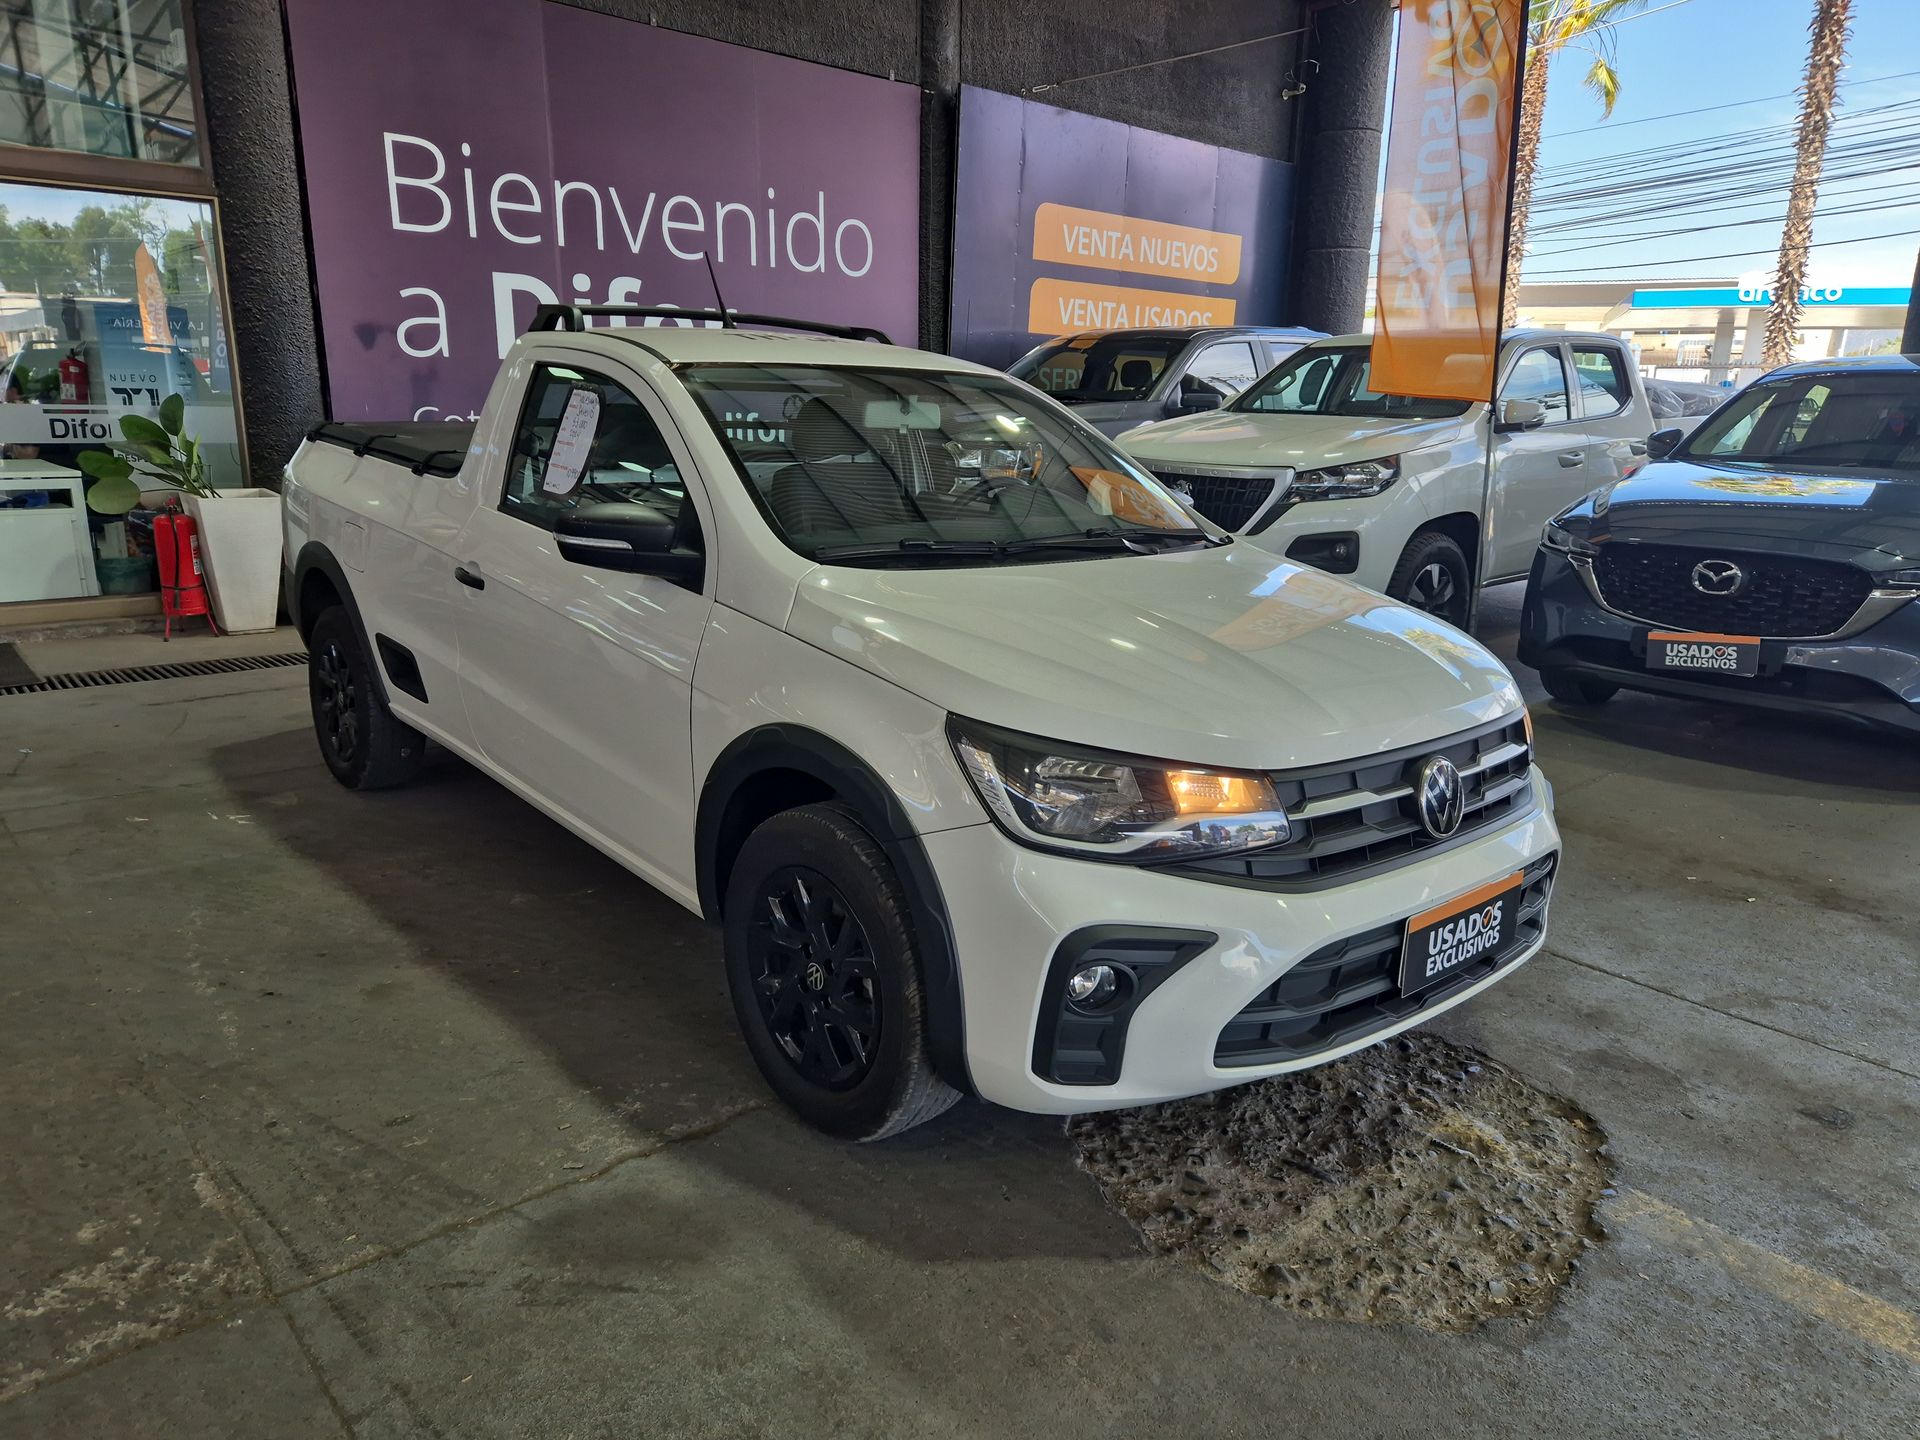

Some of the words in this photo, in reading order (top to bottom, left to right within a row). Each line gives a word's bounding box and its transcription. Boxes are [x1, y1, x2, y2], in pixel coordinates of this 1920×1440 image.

[382, 131, 874, 278] Bienvenido
[1062, 223, 1134, 262] VENTA
[1140, 235, 1219, 273] NUEVOS
[396, 286, 450, 358] a
[1058, 296, 1129, 331] VENTA
[109, 373, 158, 384] NUEVO
[1664, 655, 1738, 670] EXCLUSIVOS
[1665, 642, 1738, 660] USADOS
[1425, 925, 1500, 978] EXCLUSIVOS
[1427, 900, 1504, 956] USADOS
